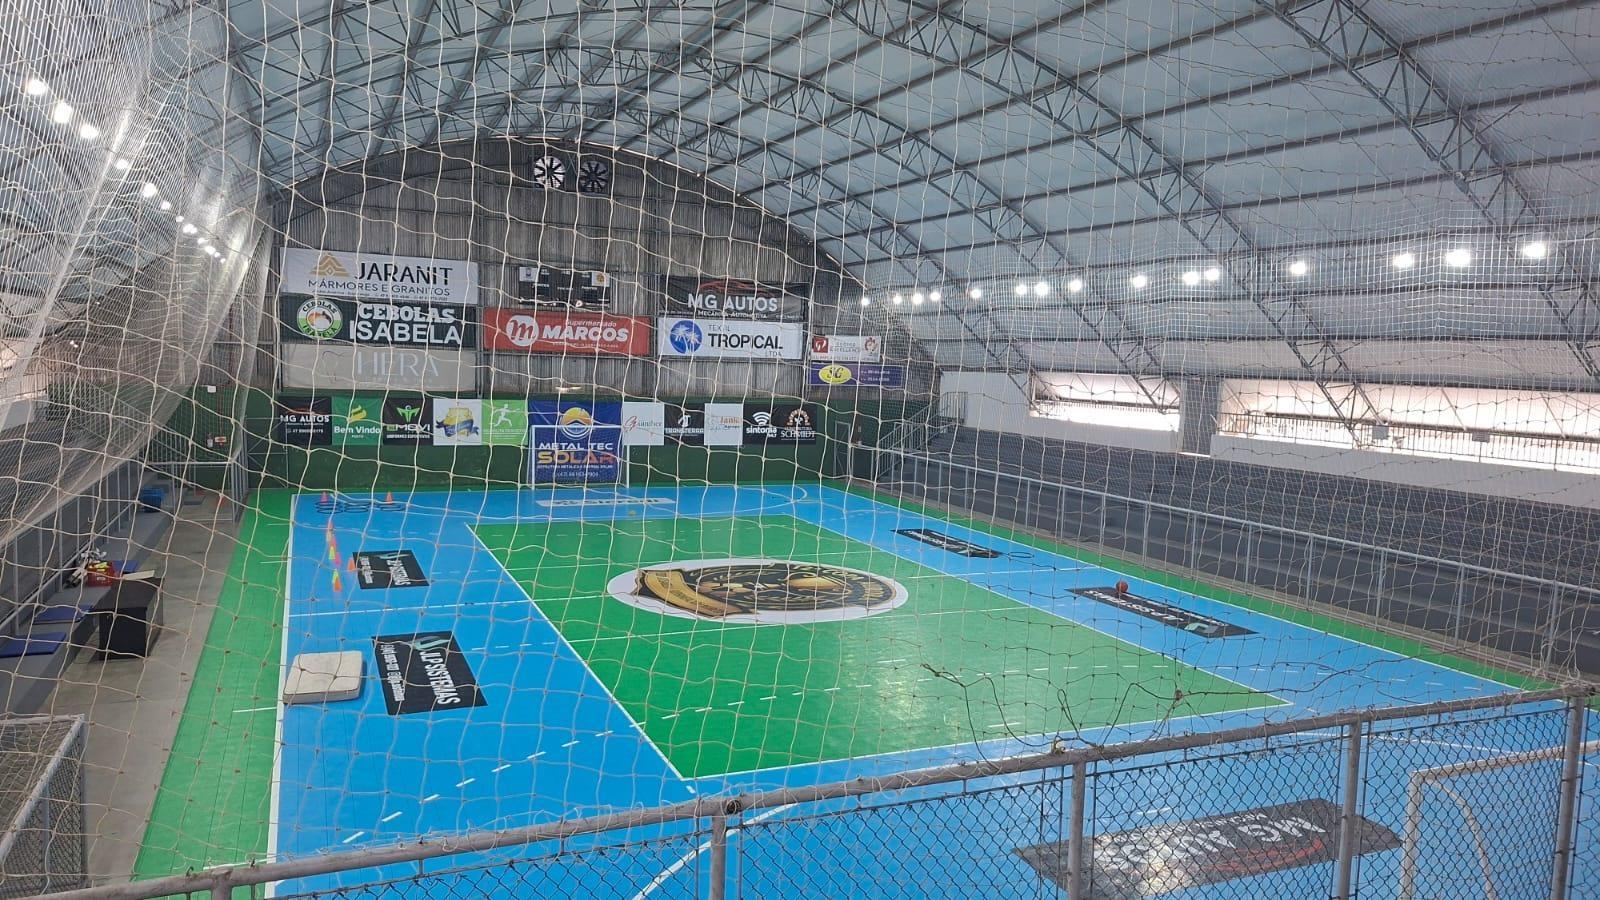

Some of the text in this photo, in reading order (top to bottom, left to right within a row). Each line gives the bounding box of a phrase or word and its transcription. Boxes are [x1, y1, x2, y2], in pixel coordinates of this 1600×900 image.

[308, 279, 378, 292] MÁRMORES
[381, 284, 388, 293] E
[391, 284, 450, 296] GRANITOS
[687, 293, 778, 312] MG AUTOS
[358, 303, 455, 324] CEBOLAS
[349, 320, 462, 345] ISABELA
[543, 324, 629, 342] MARCOS
[708, 333, 783, 349] TROPICAL
[357, 351, 439, 377] HERA
[280, 414, 330, 423] MG AUTOS
[334, 426, 381, 434] Bem Vindo
[539, 442, 613, 451] METAL TEC
[537, 450, 615, 464] SOLAR
[425, 664, 460, 704] SISTEMAS
